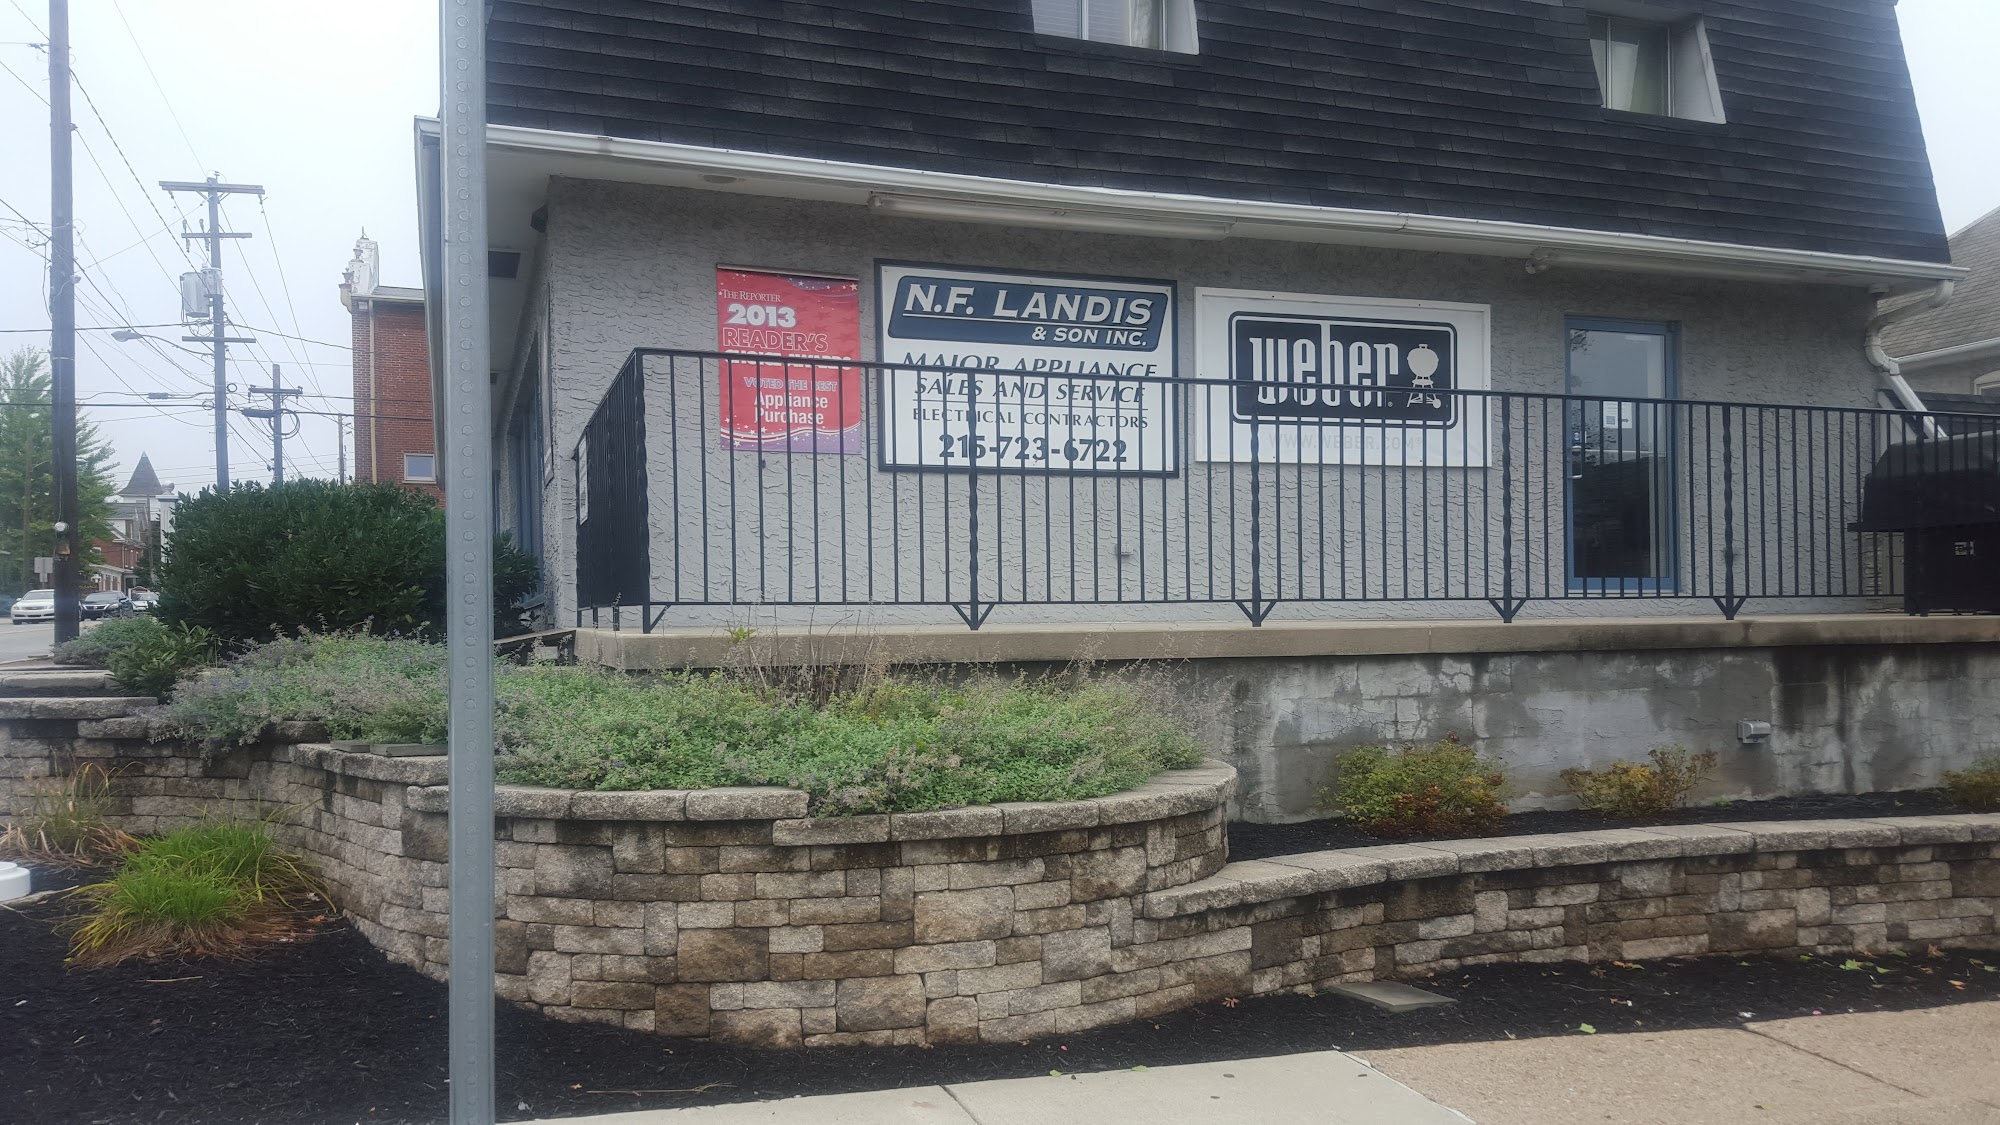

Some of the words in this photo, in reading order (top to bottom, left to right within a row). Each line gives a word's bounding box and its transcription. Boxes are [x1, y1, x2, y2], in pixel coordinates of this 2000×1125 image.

[722, 289, 739, 299] THE
[740, 290, 781, 303] REPORTER
[904, 283, 975, 315] N.F.
[993, 289, 1154, 325] LANDIS
[725, 303, 796, 328] 2013
[723, 328, 829, 352] READER'S
[1032, 326, 1047, 341] &
[1053, 327, 1101, 344] SON
[1105, 329, 1147, 346] INC.
[903, 352, 1000, 375] MAJOR
[1014, 357, 1157, 379] APPLIANCE
[1249, 321, 1399, 407] weber
[743, 377, 784, 390] VOTED
[786, 380, 808, 391] THE
[914, 377, 984, 397] SALES
[992, 381, 1047, 399] AND
[1055, 383, 1146, 403] SERVICE
[754, 407, 825, 425] Purchase
[1023, 412, 1149, 428] CONTRACTORS
[938, 434, 1127, 463] 215-723-6722
